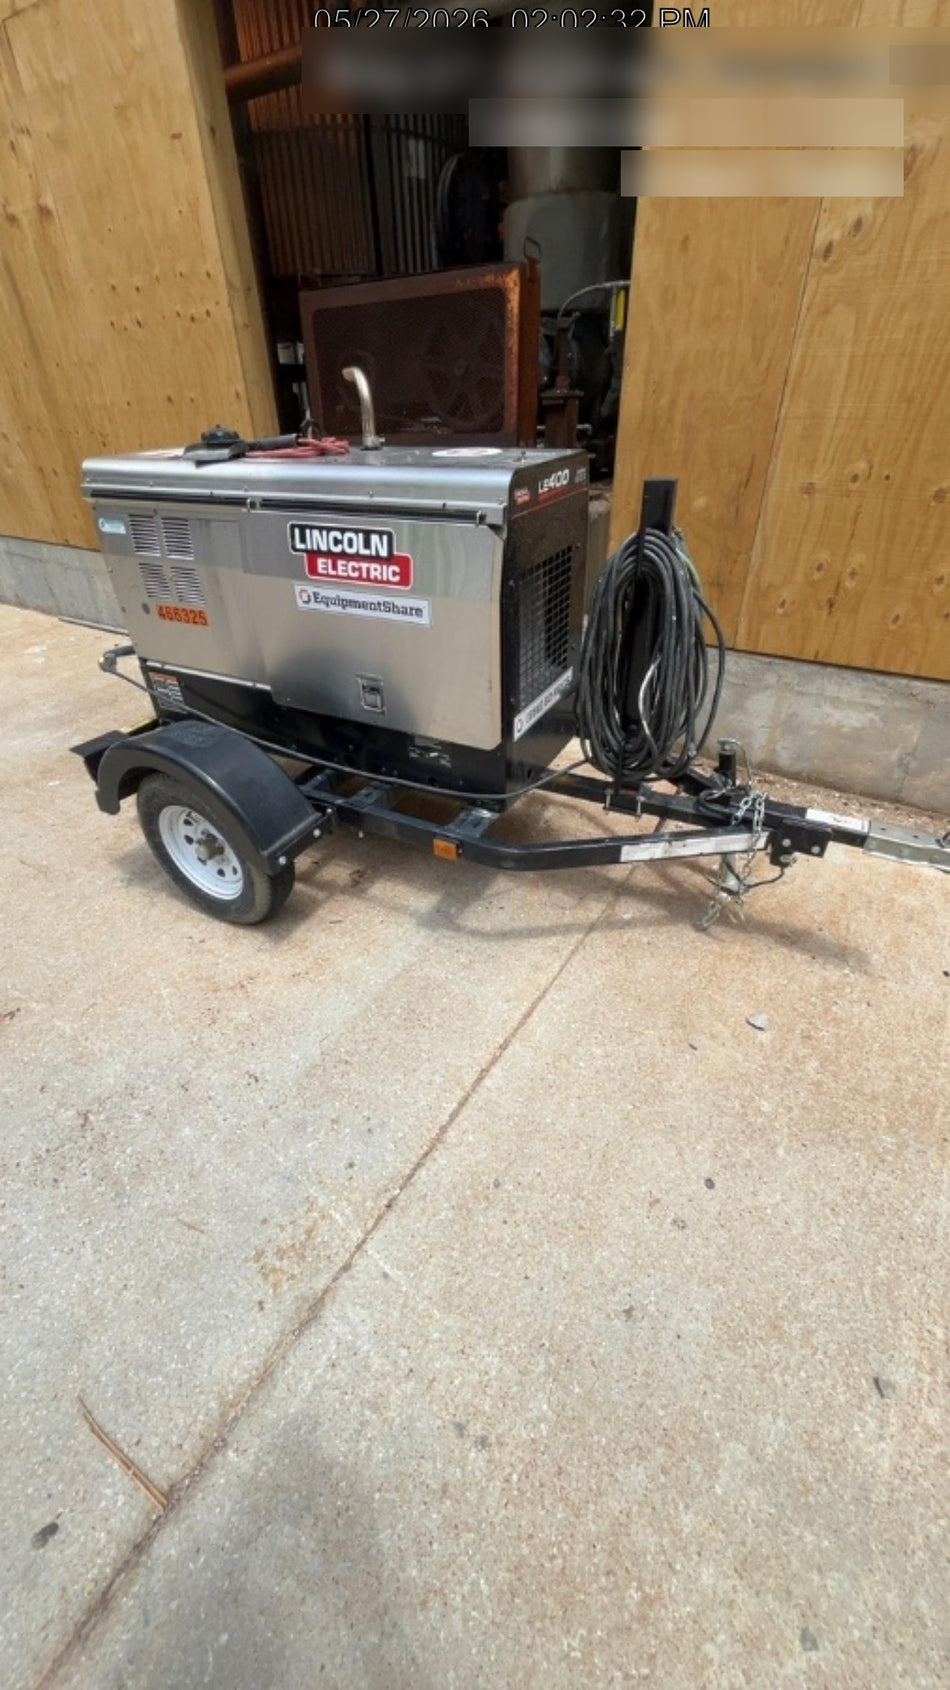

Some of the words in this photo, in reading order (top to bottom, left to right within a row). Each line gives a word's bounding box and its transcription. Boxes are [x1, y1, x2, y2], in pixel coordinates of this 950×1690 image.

[293, 527, 389, 557] LINCOLN
[316, 558, 401, 582] ELECTRIC
[157, 604, 207, 626] 466325
[312, 591, 424, 618] EquipmentShare
